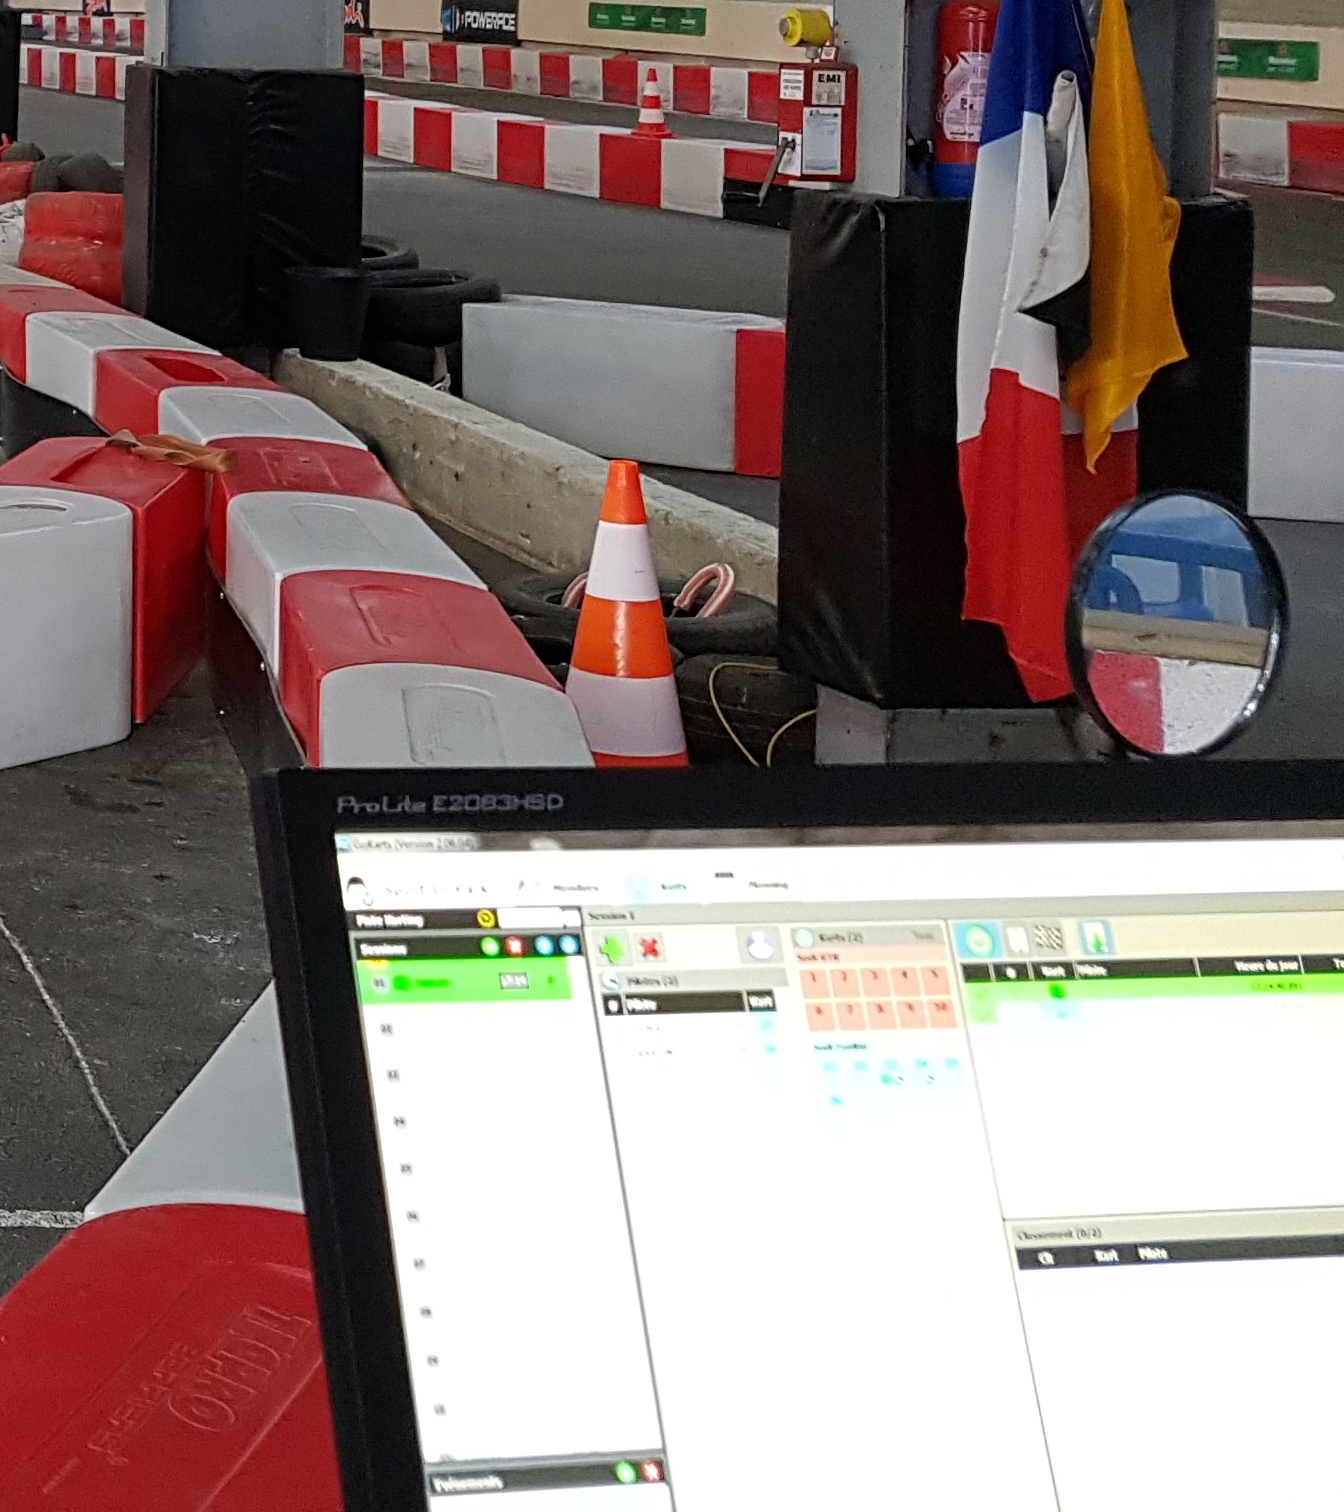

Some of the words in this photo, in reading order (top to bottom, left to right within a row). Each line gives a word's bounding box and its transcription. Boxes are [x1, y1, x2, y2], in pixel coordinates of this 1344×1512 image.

[464, 10, 516, 31] POWERADE
[817, 73, 841, 84] EMI
[337, 795, 426, 814] ProLite
